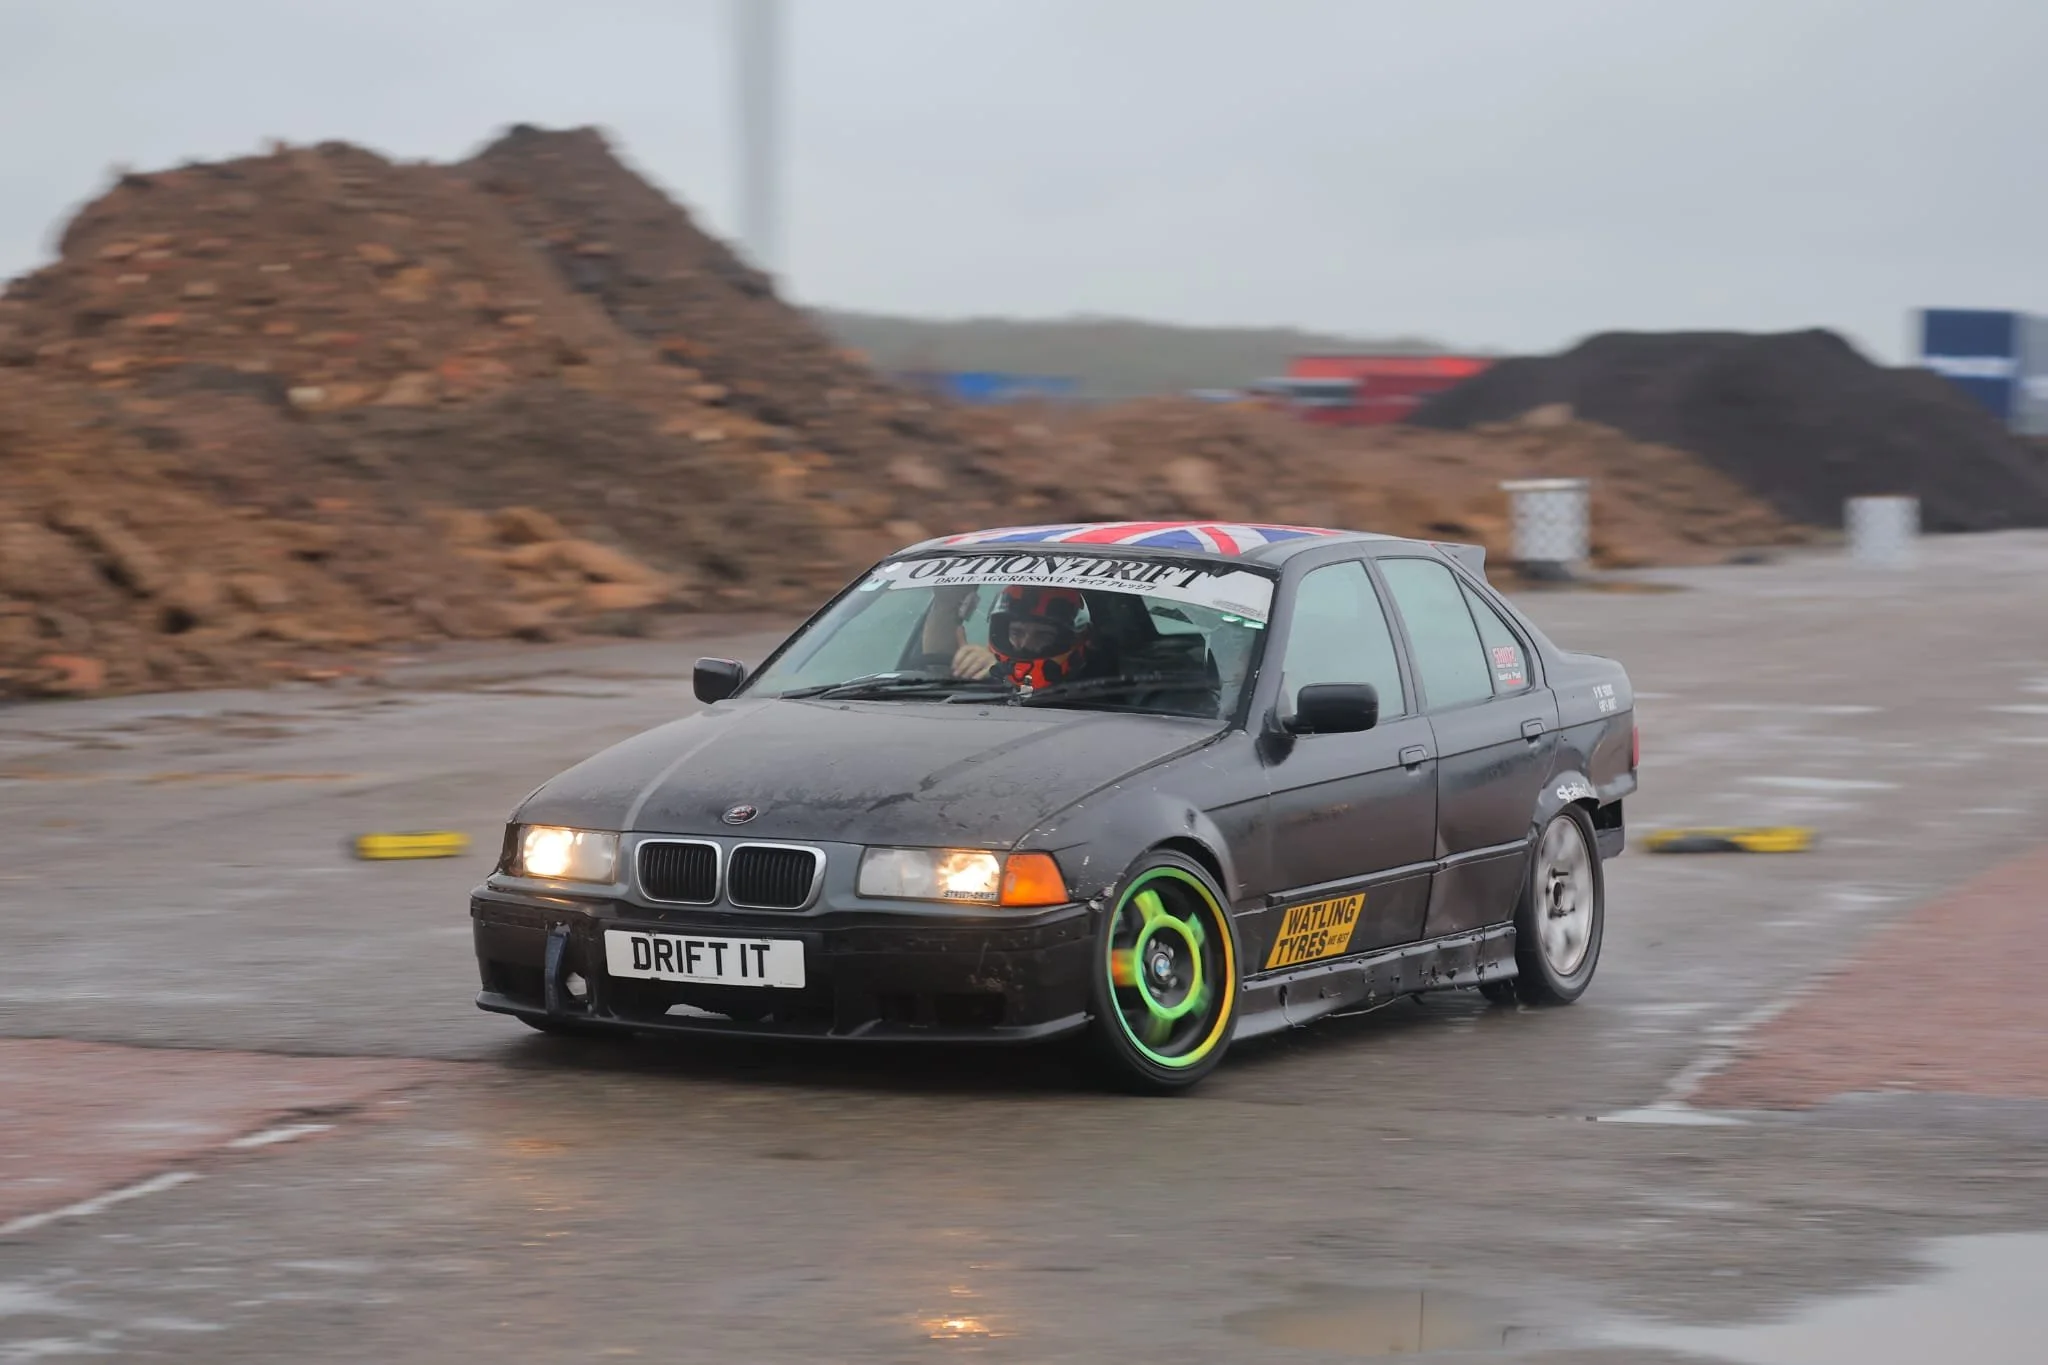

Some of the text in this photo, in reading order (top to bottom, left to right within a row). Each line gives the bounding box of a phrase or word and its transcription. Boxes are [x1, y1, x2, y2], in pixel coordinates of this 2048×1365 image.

[934, 575, 978, 583] DRIVE
[1287, 897, 1356, 936] WATLING
[631, 936, 770, 978] DRIFT IT
[1276, 929, 1328, 965] TYRES
